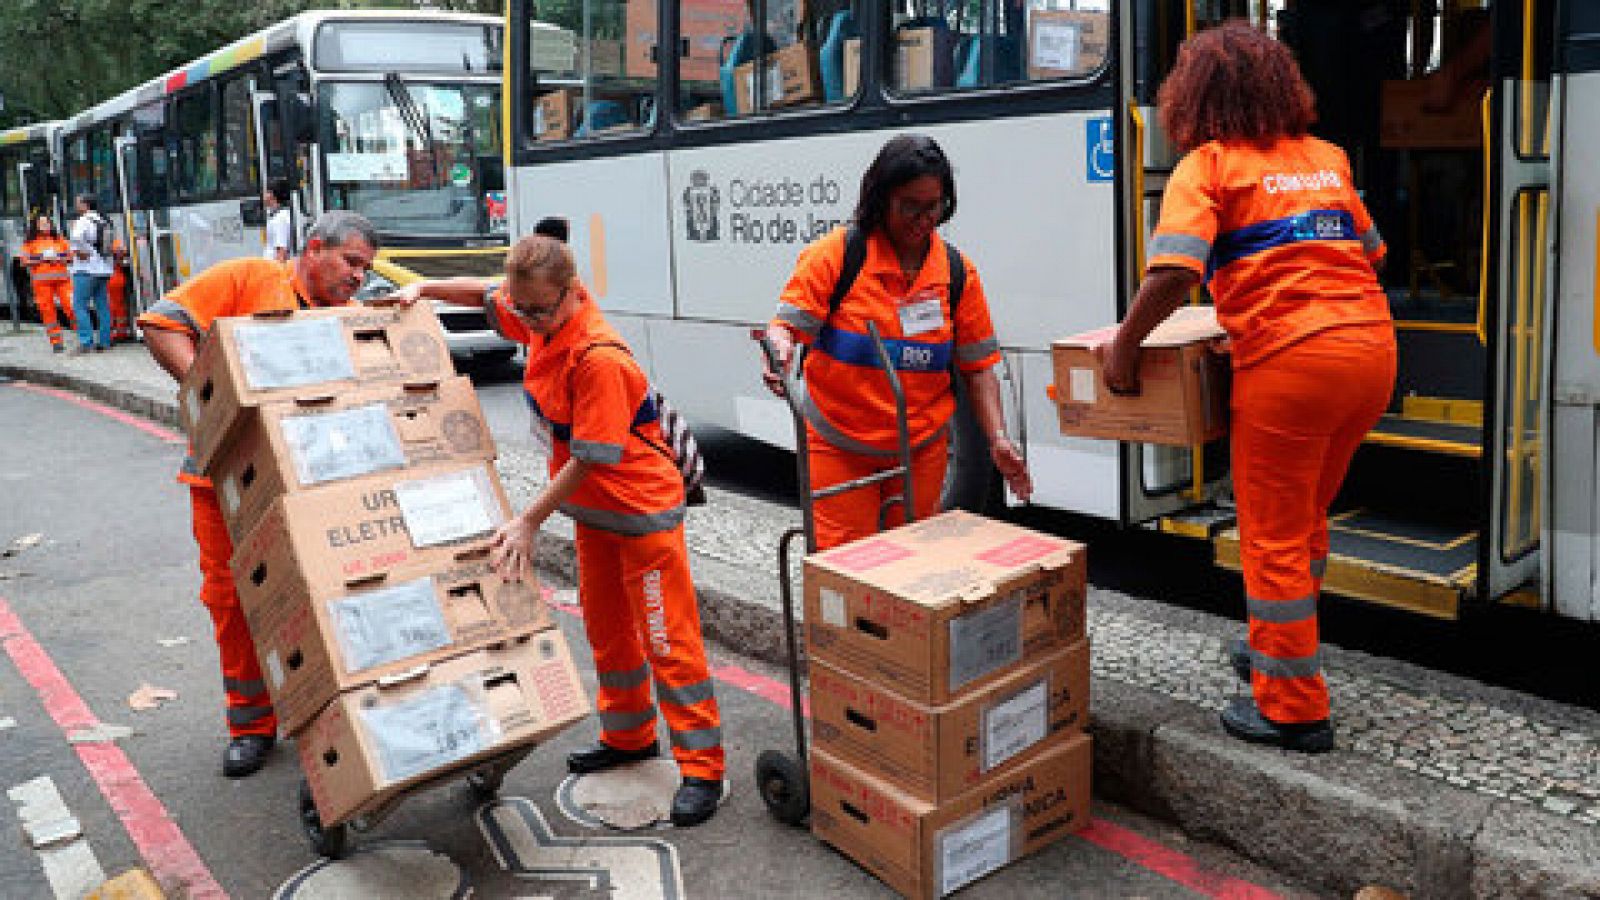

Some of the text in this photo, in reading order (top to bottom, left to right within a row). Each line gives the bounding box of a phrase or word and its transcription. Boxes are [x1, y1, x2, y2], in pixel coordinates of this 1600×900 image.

[728, 173, 841, 208] Cidade do
[728, 212, 763, 244] Rio
[766, 213, 798, 244] de
